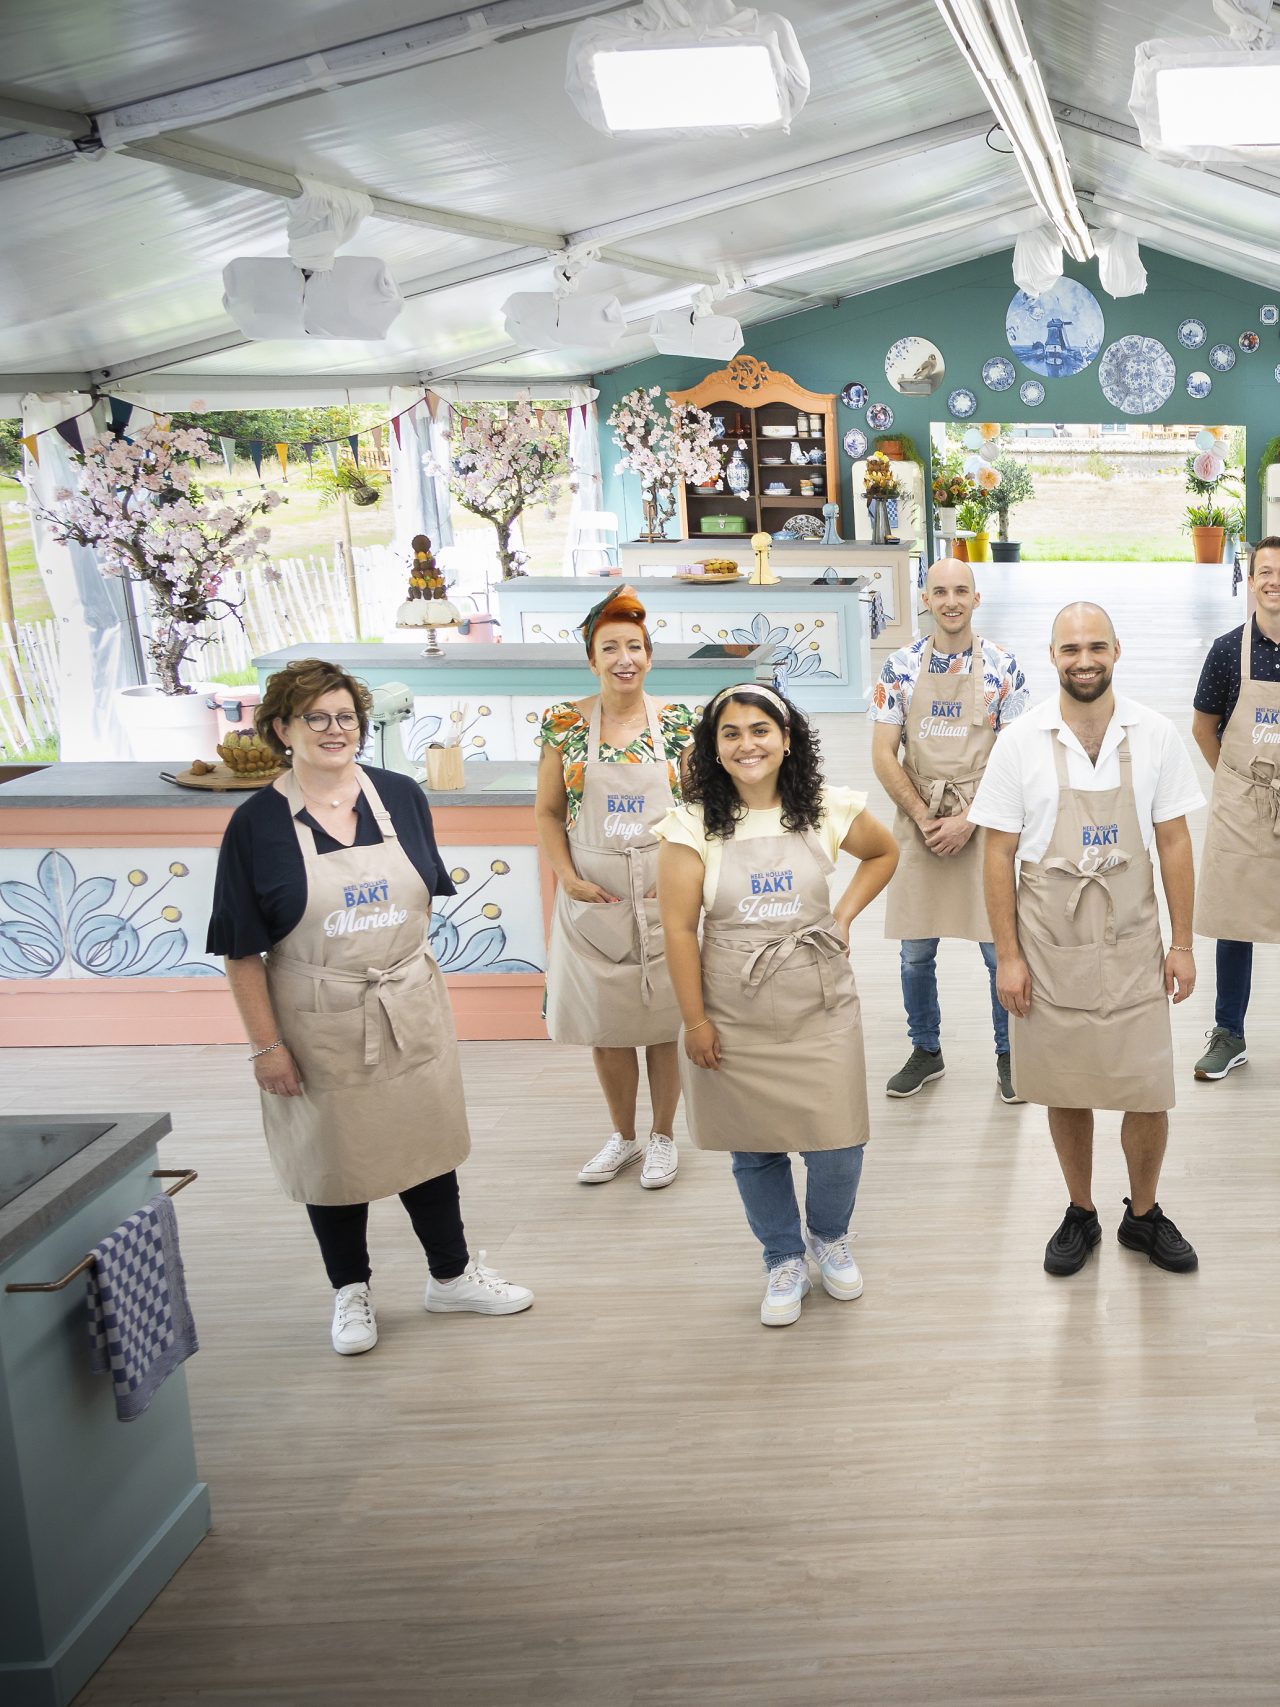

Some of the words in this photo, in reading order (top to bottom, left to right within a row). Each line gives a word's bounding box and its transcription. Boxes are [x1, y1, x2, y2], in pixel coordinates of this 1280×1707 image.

[931, 704, 962, 718] BAKT
[918, 716, 969, 739] Juliaan
[607, 799, 645, 813] BAKT
[603, 813, 643, 841] Inge
[1082, 828, 1119, 846] BAKT
[344, 884, 389, 908] BAKT
[751, 875, 793, 895] BAKT
[738, 894, 804, 923] Zeinab
[323, 903, 408, 938] Marieke
